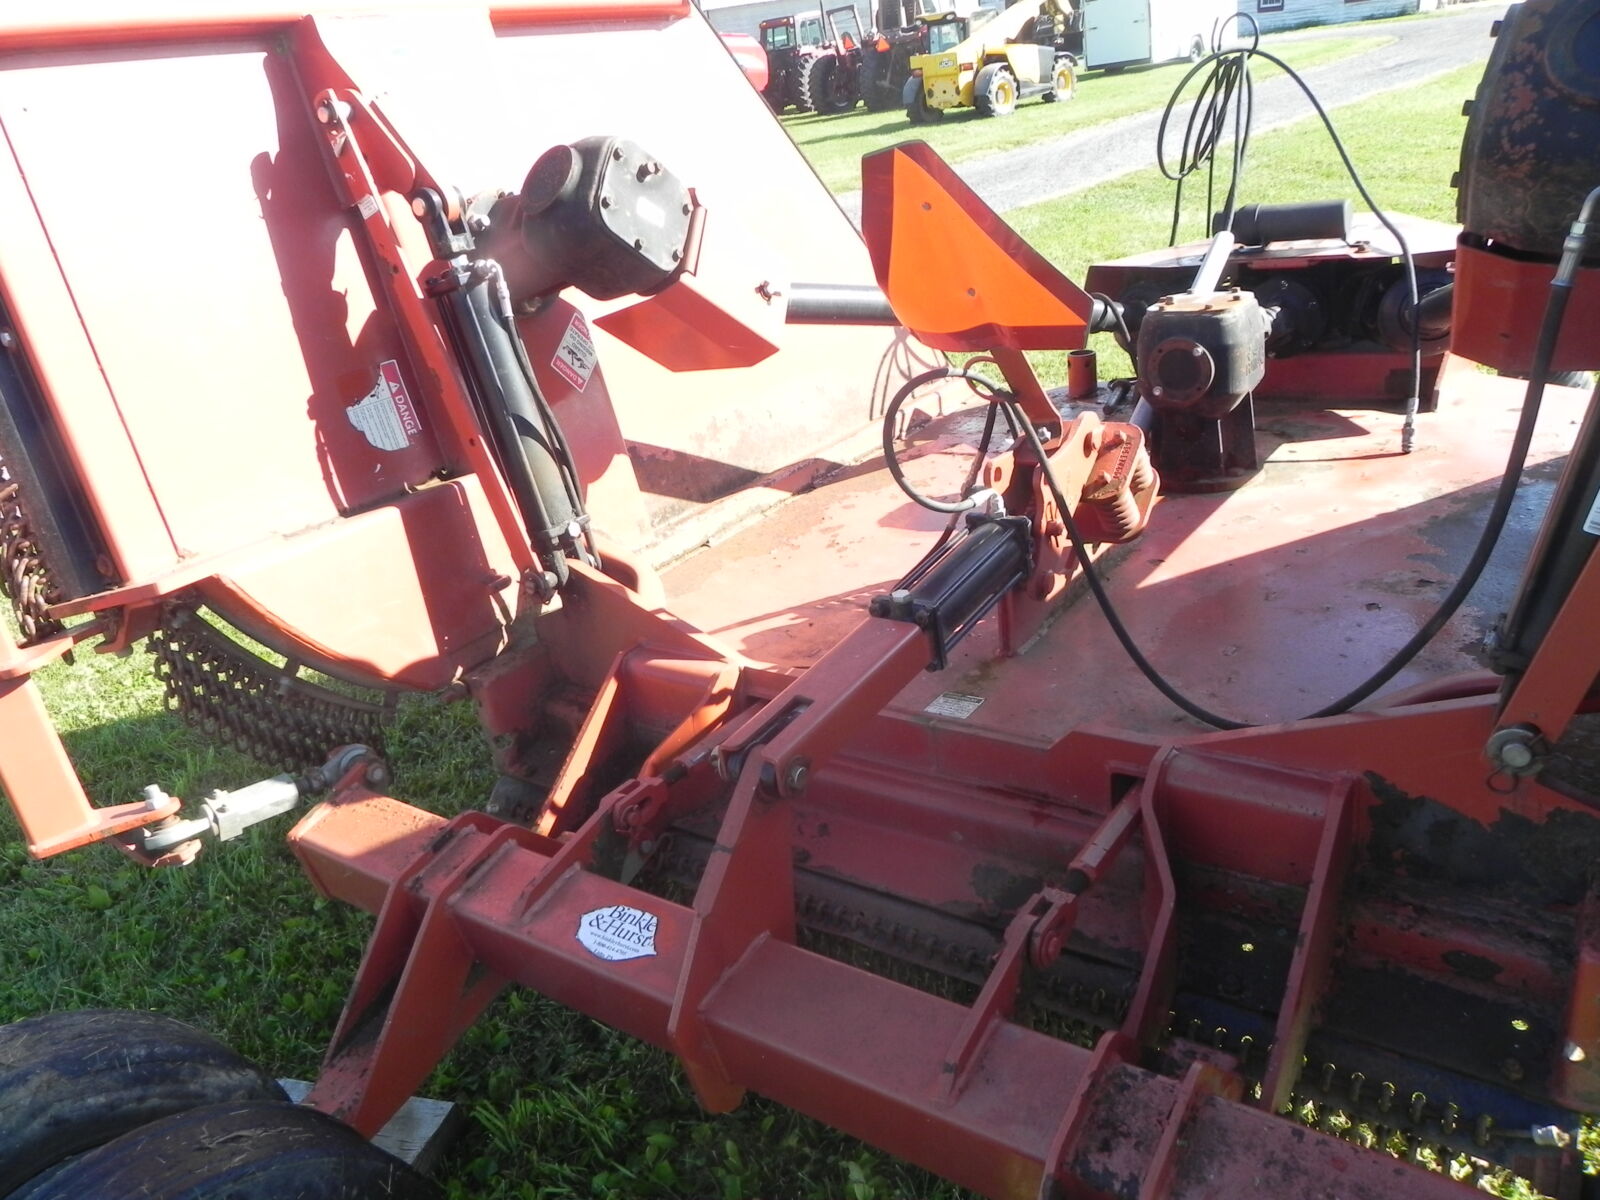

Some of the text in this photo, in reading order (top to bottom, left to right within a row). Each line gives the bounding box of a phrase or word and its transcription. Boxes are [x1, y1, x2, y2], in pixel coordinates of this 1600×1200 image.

[555, 360, 578, 381] DANGER
[395, 395, 418, 436] DANGE
[608, 905, 656, 934] Binkle
